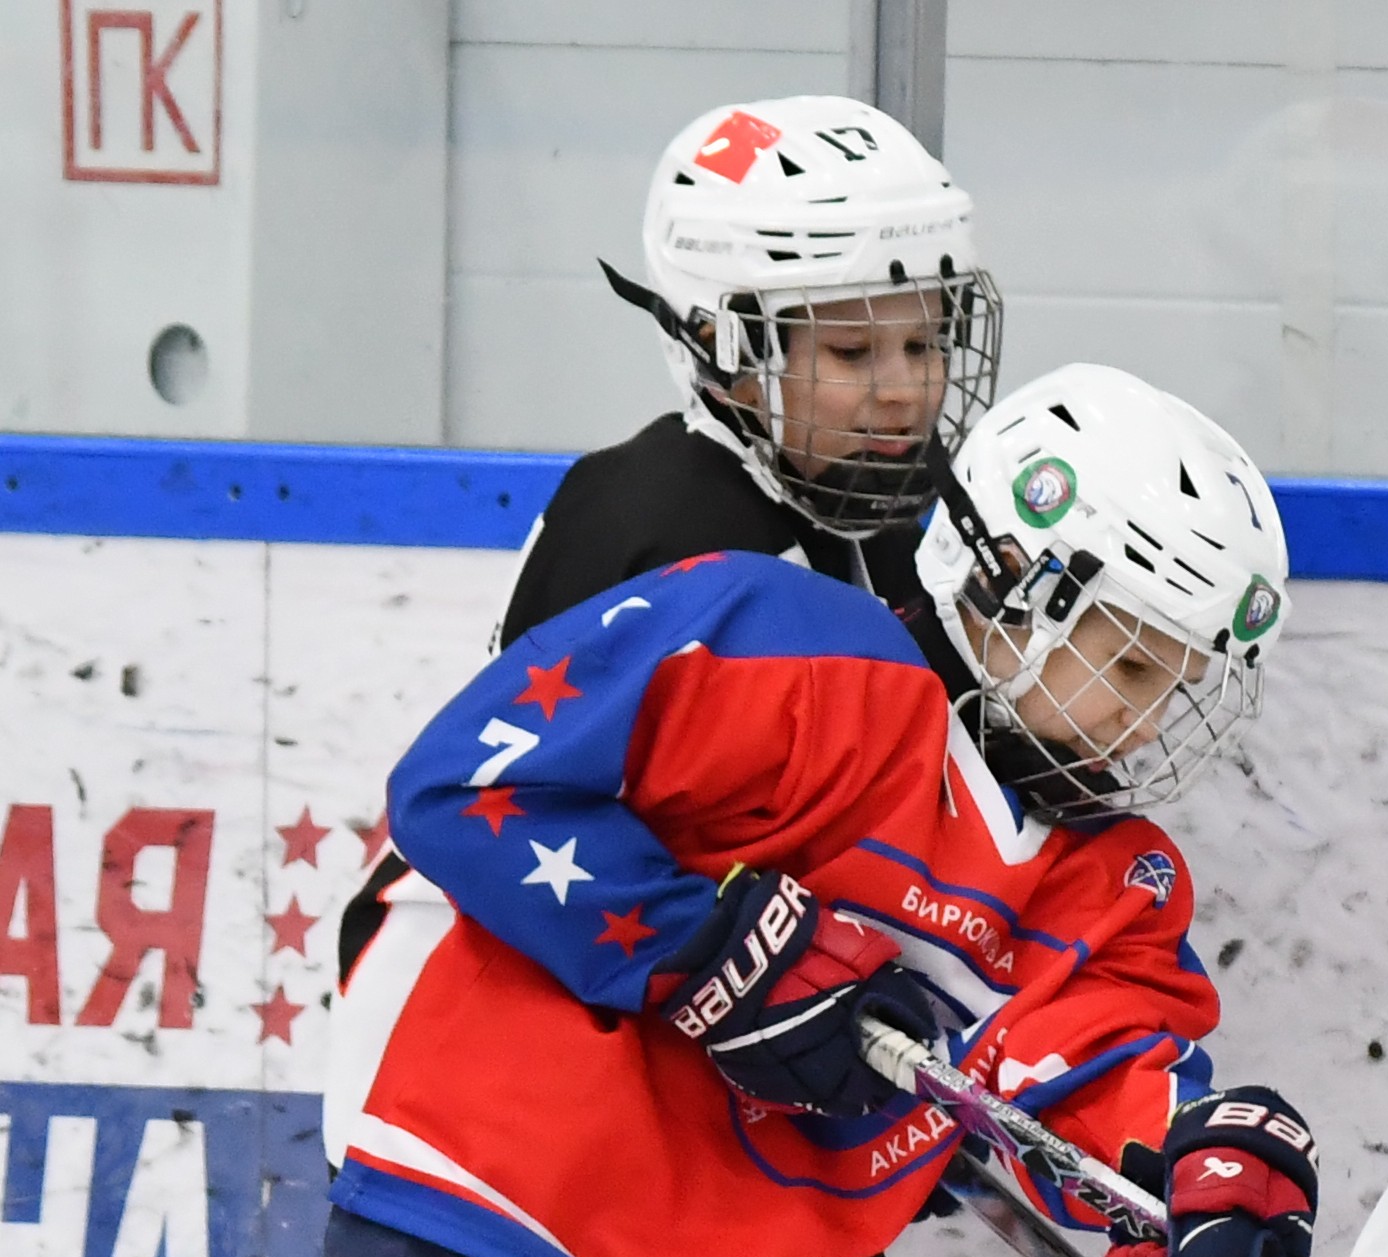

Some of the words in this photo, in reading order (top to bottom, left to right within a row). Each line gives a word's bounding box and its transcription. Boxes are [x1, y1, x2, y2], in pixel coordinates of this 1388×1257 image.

[813, 126, 879, 162] 17
[467, 717, 540, 787] 7
[0, 802, 216, 1030] АЯ
[669, 873, 812, 1039] BAUER
